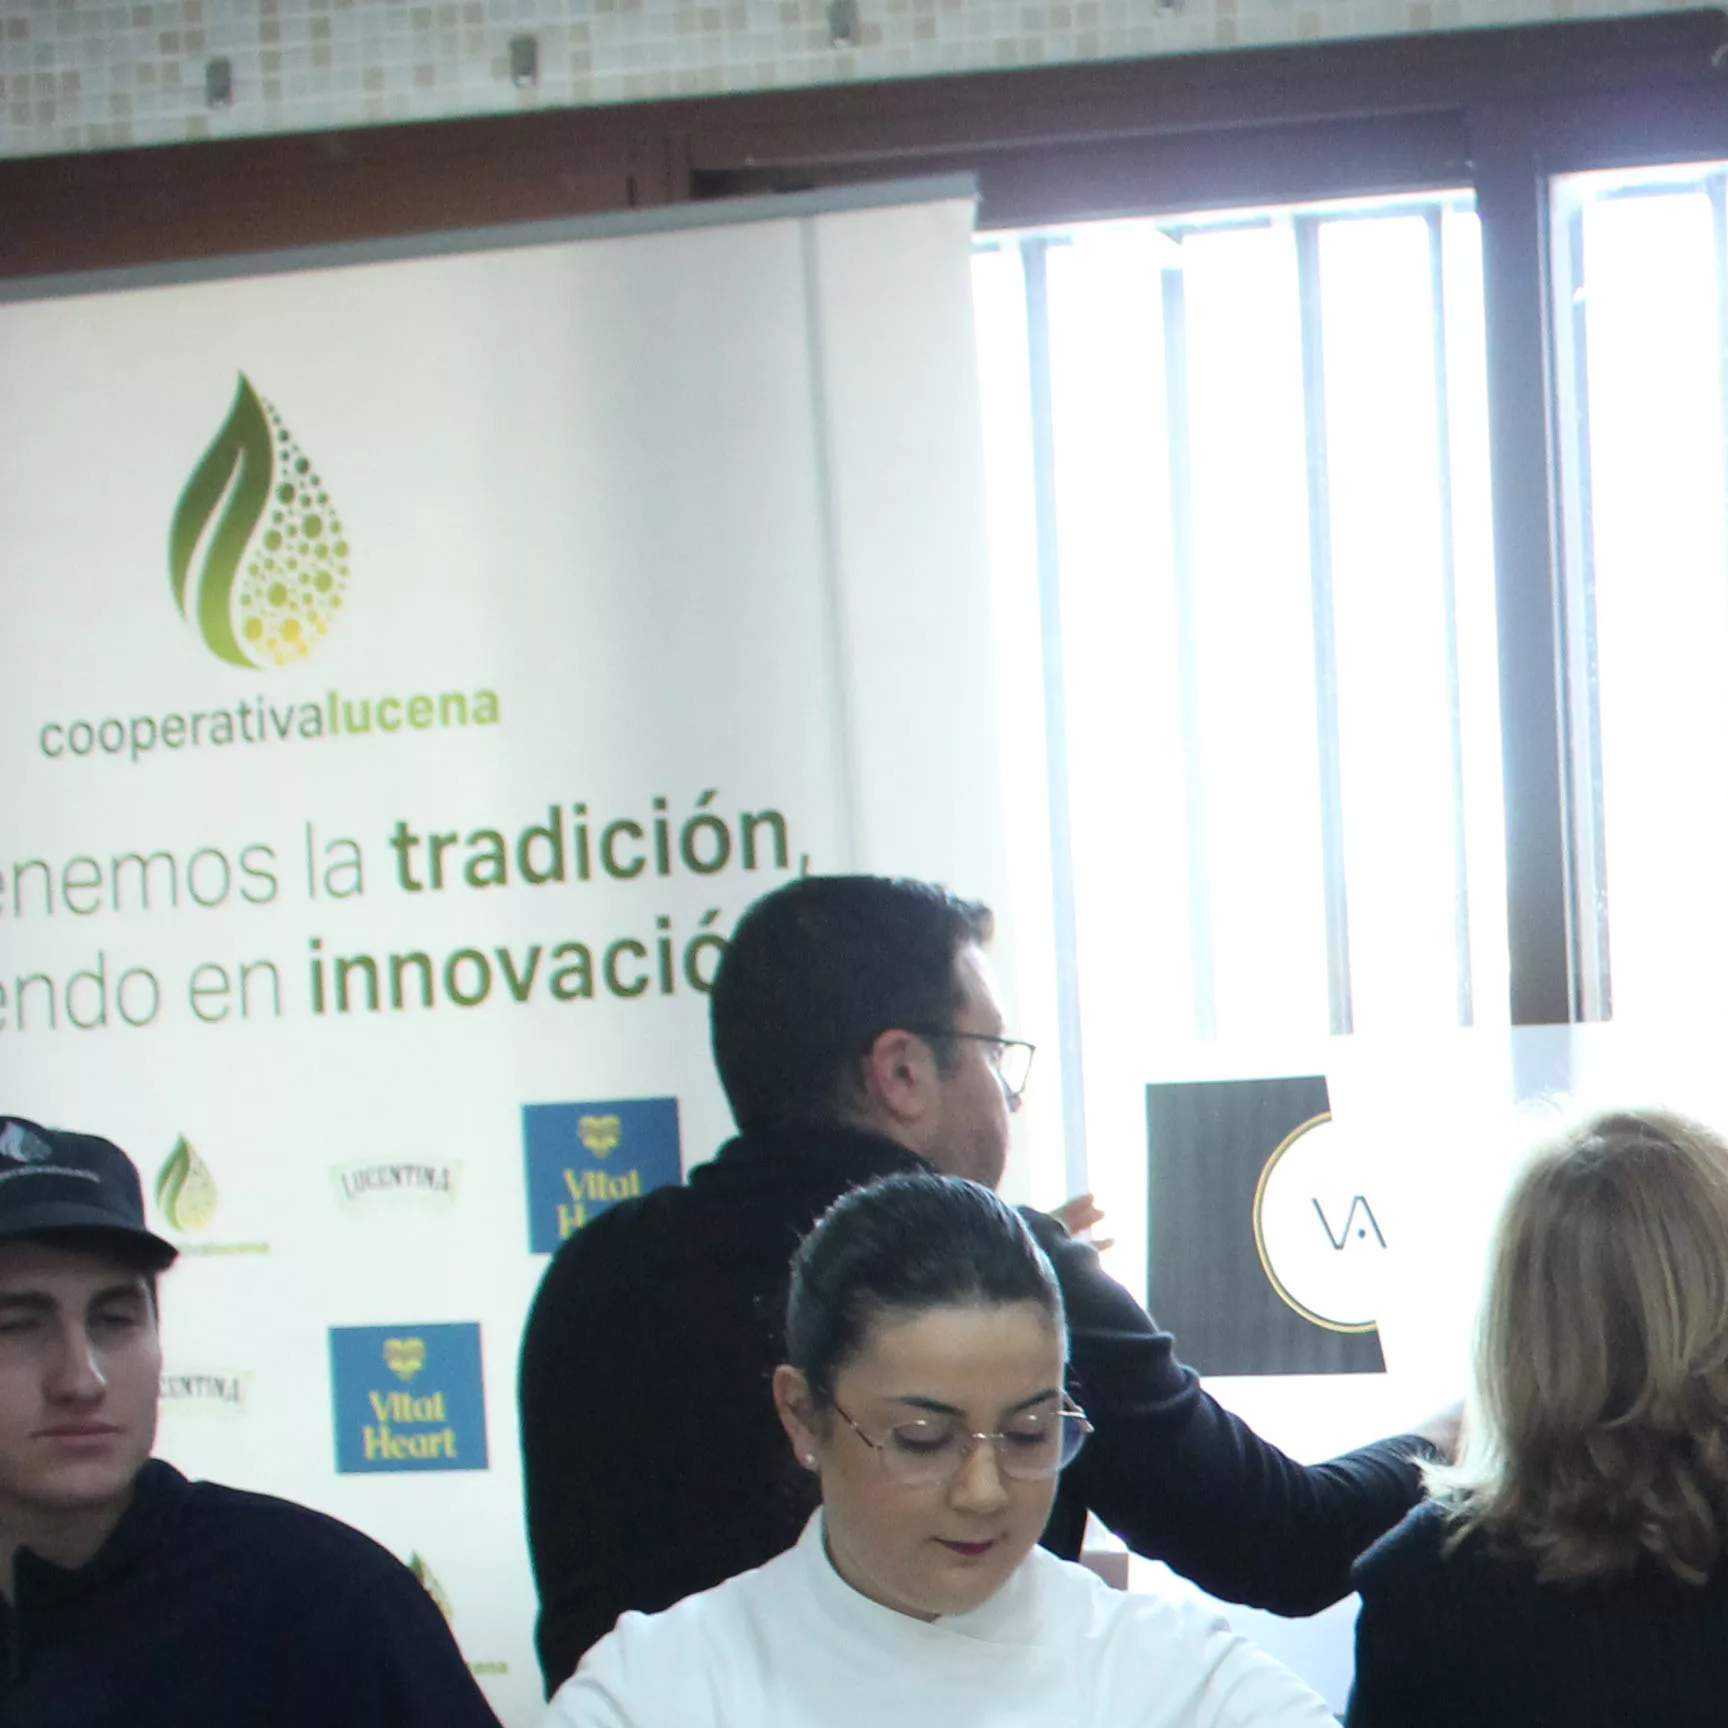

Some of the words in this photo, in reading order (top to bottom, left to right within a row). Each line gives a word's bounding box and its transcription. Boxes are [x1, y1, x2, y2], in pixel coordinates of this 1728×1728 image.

[39, 687, 501, 763] cooperativalucena
[0, 843, 278, 918] nemos
[305, 820, 364, 900] la
[388, 789, 810, 893] tradición,
[0, 950, 161, 1031] ndo
[189, 961, 282, 1023] en
[308, 909, 731, 1016] innovació
[362, 1425, 457, 1460] Heart
[368, 1391, 446, 1424] Vital
